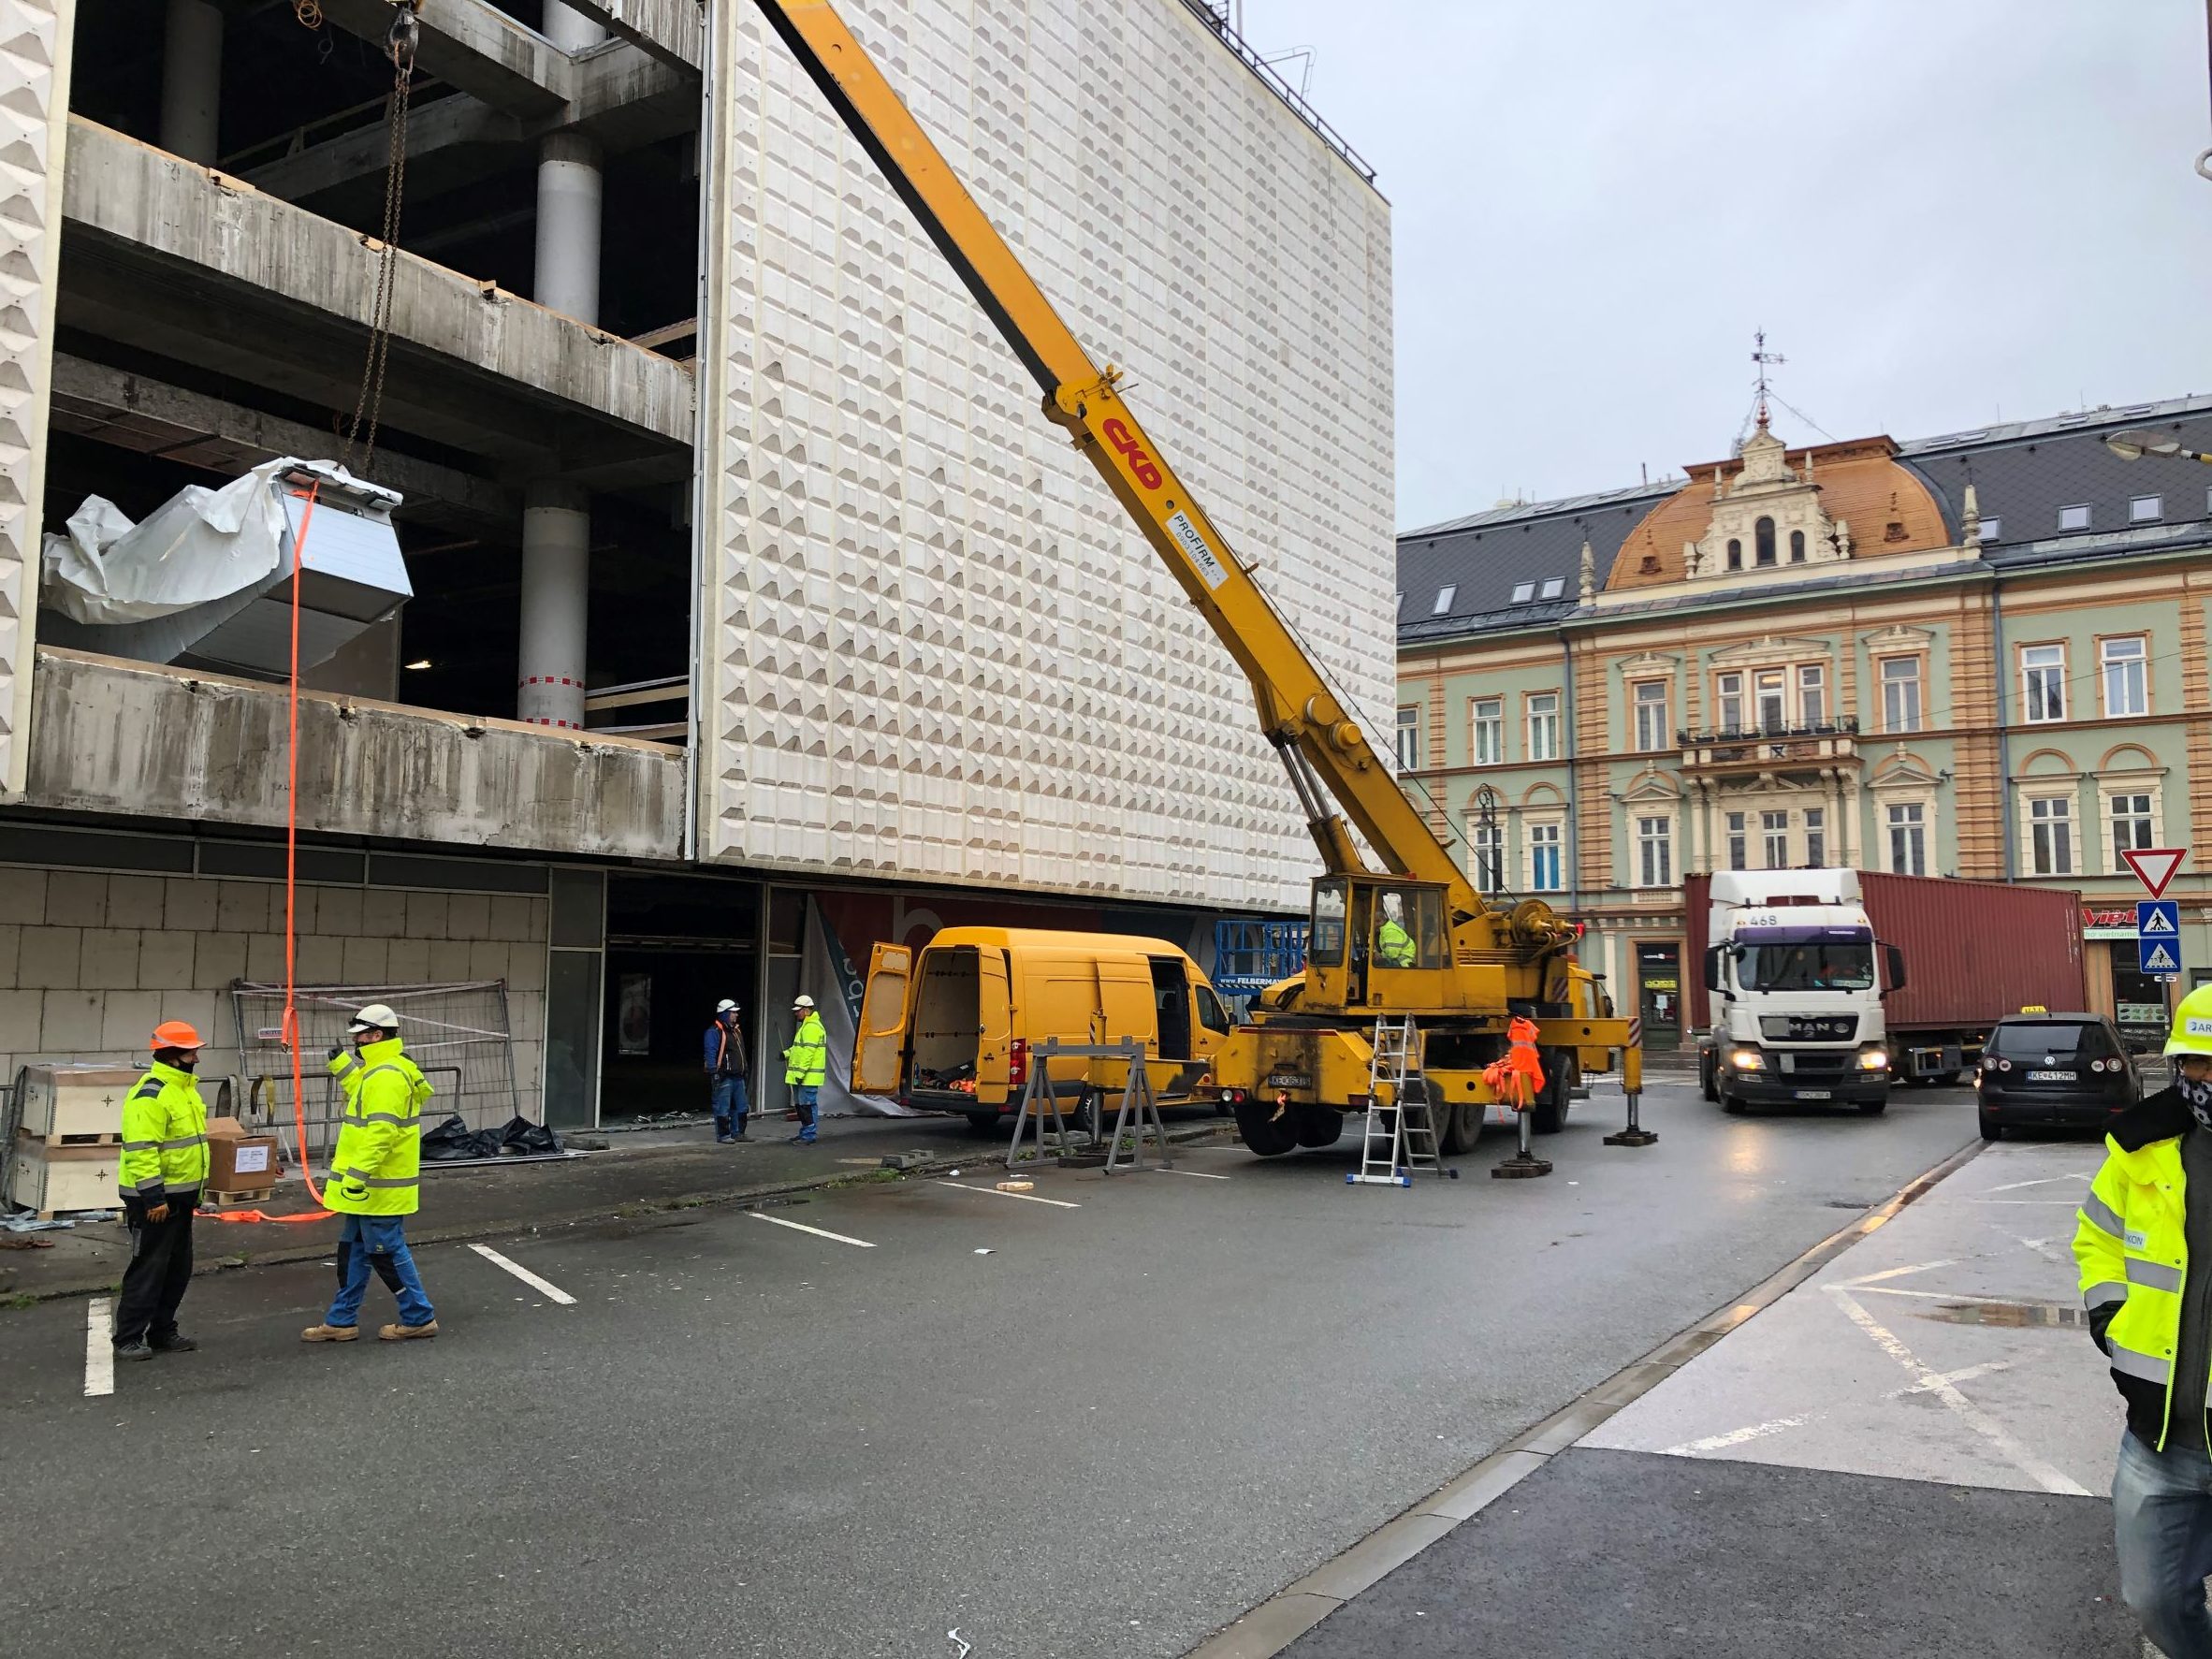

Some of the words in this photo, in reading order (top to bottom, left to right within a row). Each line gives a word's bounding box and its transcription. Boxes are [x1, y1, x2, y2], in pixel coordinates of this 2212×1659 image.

[1102, 418, 1163, 490] CKD
[1173, 515, 1215, 567] PROFIRM
[1750, 915, 1777, 925] 468
[1789, 1023, 1830, 1031] MAN
